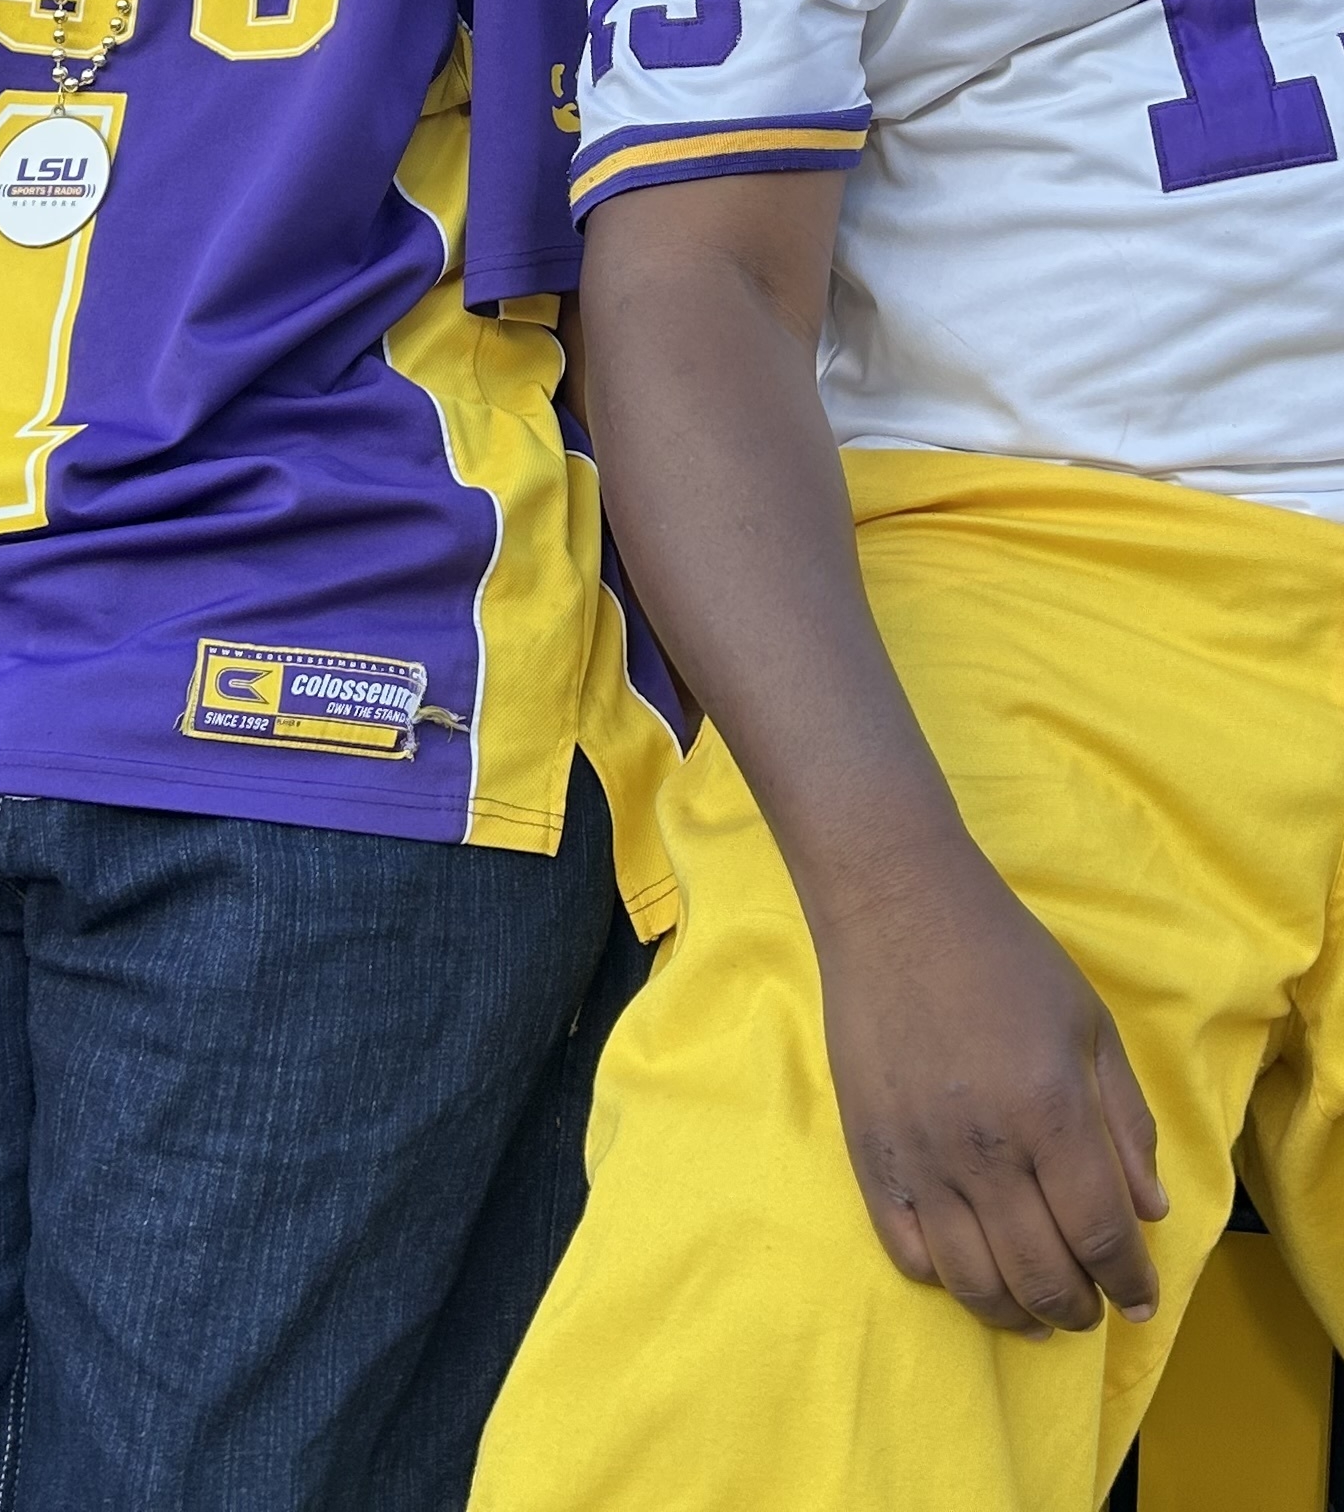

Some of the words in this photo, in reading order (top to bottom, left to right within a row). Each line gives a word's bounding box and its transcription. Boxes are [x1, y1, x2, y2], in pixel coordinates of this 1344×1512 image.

[16, 157, 89, 181] LSU
[10, 186, 46, 196] SPORTS
[53, 186, 83, 196] RADIO
[11, 199, 78, 207] NETWORK
[325, 701, 353, 716] OWN
[353, 704, 373, 720] THE
[203, 711, 239, 728] SINCE
[240, 714, 270, 732] 1992
